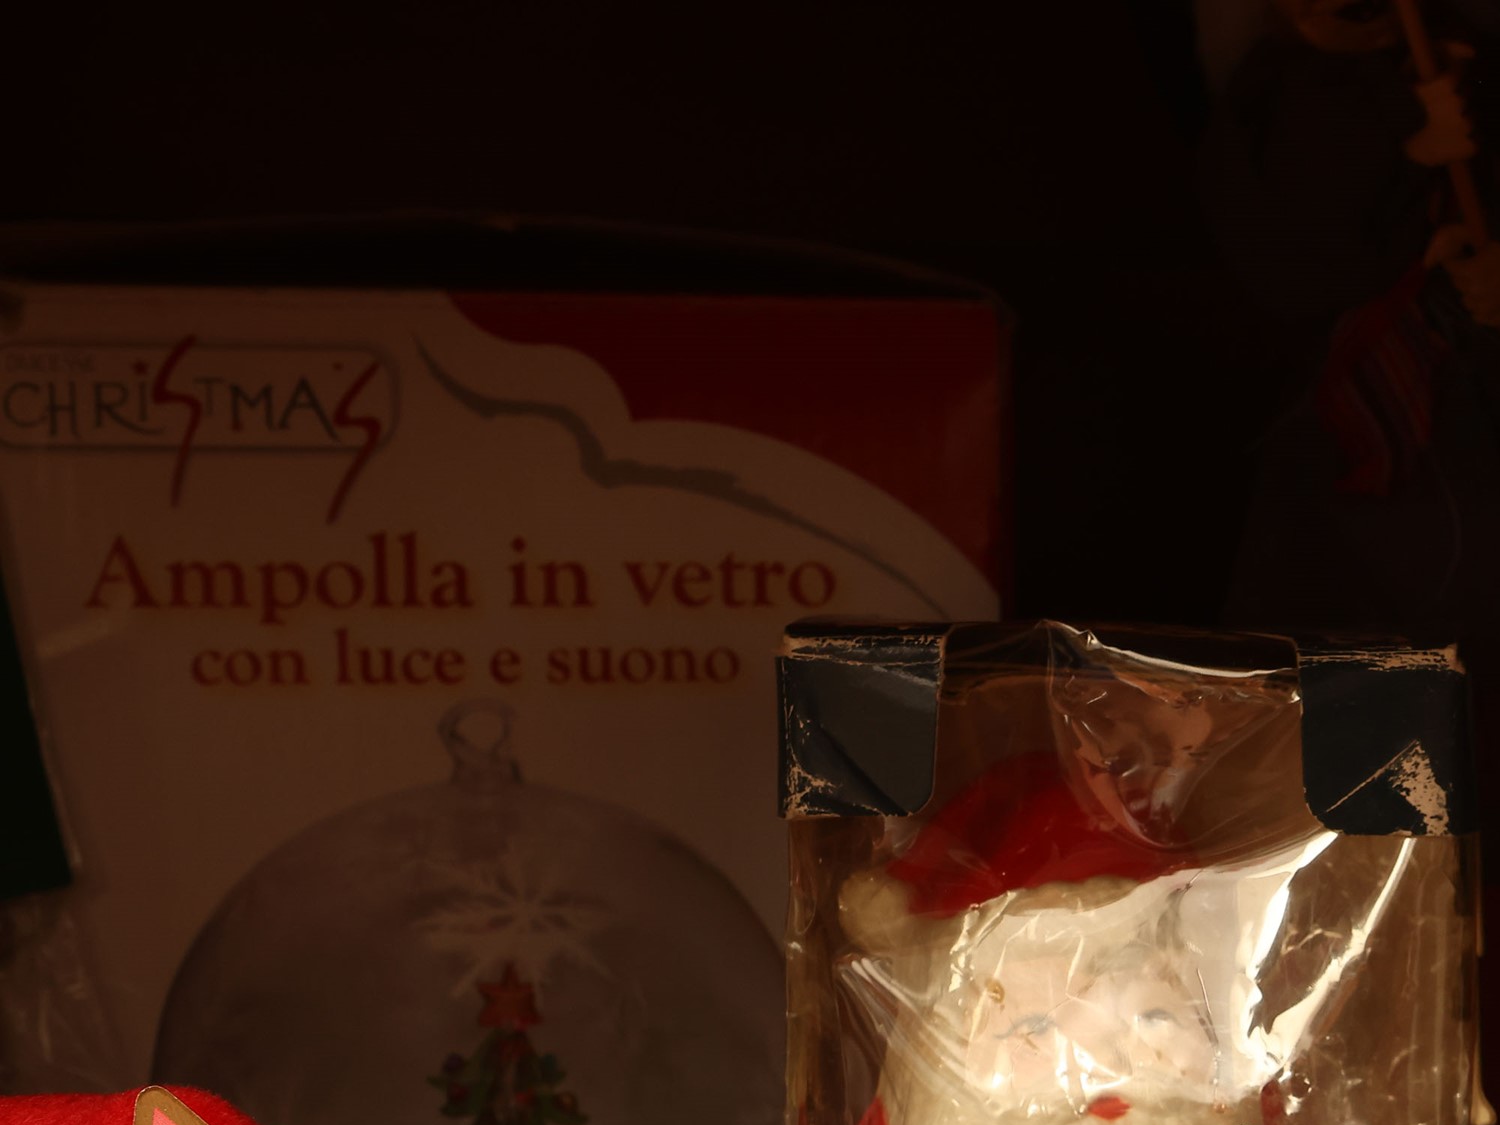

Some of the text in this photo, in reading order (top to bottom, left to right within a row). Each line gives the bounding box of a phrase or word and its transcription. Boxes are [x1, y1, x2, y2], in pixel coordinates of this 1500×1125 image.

[86, 531, 837, 626] Ampolla in vetro
[190, 627, 741, 686] con luce e suono
